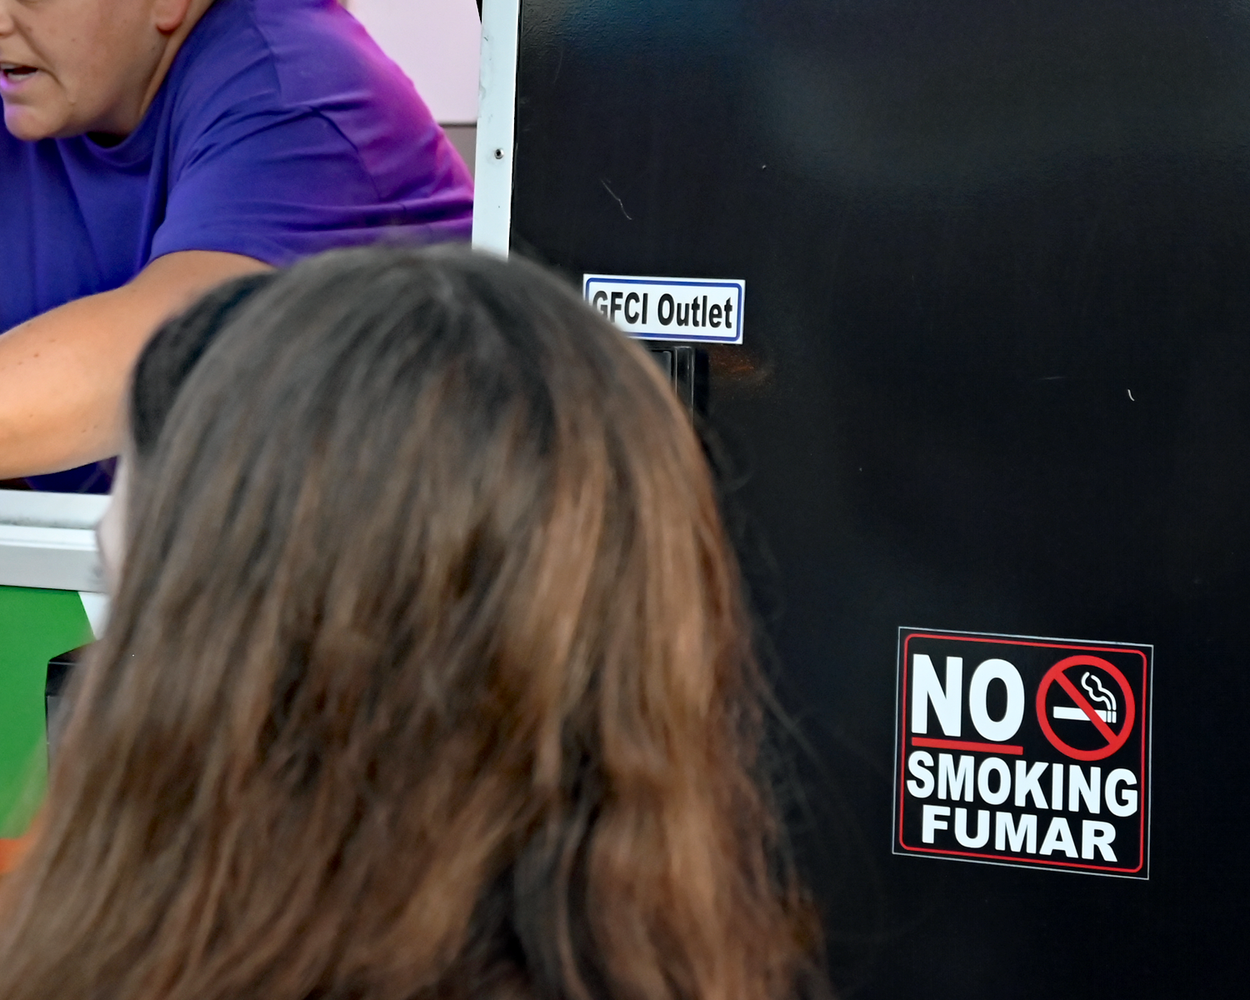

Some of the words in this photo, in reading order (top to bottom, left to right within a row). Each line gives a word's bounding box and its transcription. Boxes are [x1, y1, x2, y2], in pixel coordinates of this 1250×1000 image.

[592, 290, 648, 325] GFCI
[657, 293, 733, 329] Outlet
[911, 653, 1025, 742] NO
[906, 750, 1138, 817] SMOKING
[922, 804, 1118, 863] FUMAR
